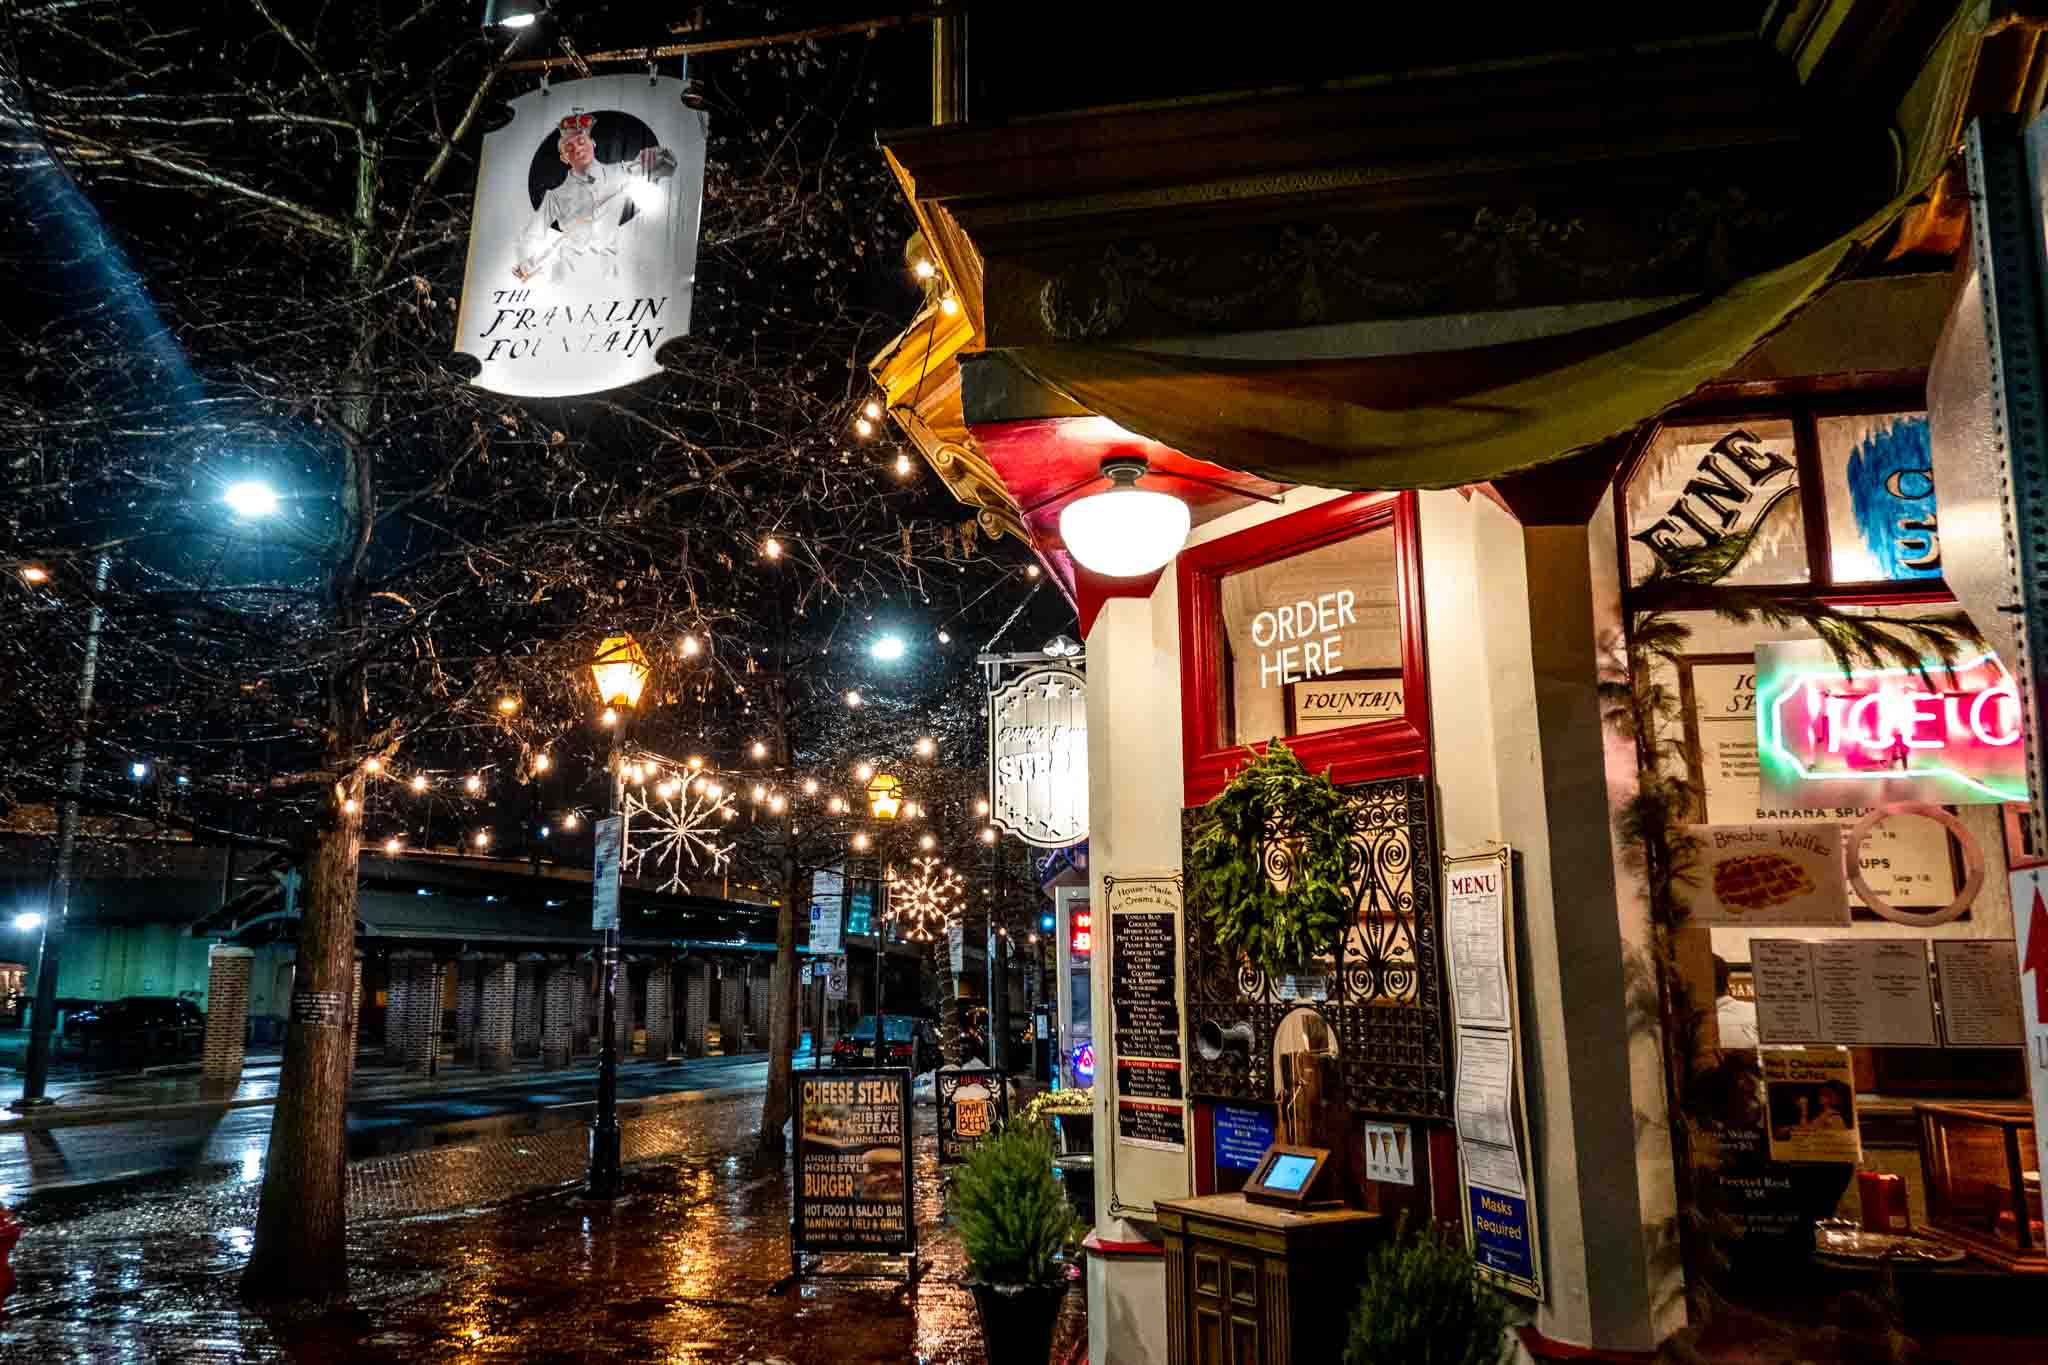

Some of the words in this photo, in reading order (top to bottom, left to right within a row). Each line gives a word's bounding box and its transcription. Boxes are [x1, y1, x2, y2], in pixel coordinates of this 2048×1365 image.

[1630, 429, 1798, 571] FINE
[1251, 589, 1358, 647] ORDER
[1260, 635, 1345, 689] HERE
[1303, 690, 1403, 713] FOUNTAIN
[1755, 807, 1826, 819] BANANA
[1450, 875, 1497, 896] MENU
[803, 1080, 855, 1105] CHEESE
[858, 1080, 900, 1105] STEAK
[852, 1111, 899, 1123] RIBEYE
[960, 1116, 988, 1131] BEER
[857, 1123, 900, 1134] STEAK
[804, 1154, 836, 1164] ANGUS
[804, 1163, 870, 1173] HOMESTYLE
[804, 1174, 853, 1198] BURGER
[804, 1204, 821, 1217] HOT
[823, 1204, 847, 1217] FOOD
[856, 1205, 884, 1217] SALAD
[886, 1206, 903, 1217] BAR
[1480, 1195, 1513, 1217] Masks
[804, 1217, 850, 1229] SANDWICH
[880, 1219, 905, 1231] GRILL
[1476, 1215, 1522, 1241] Required
